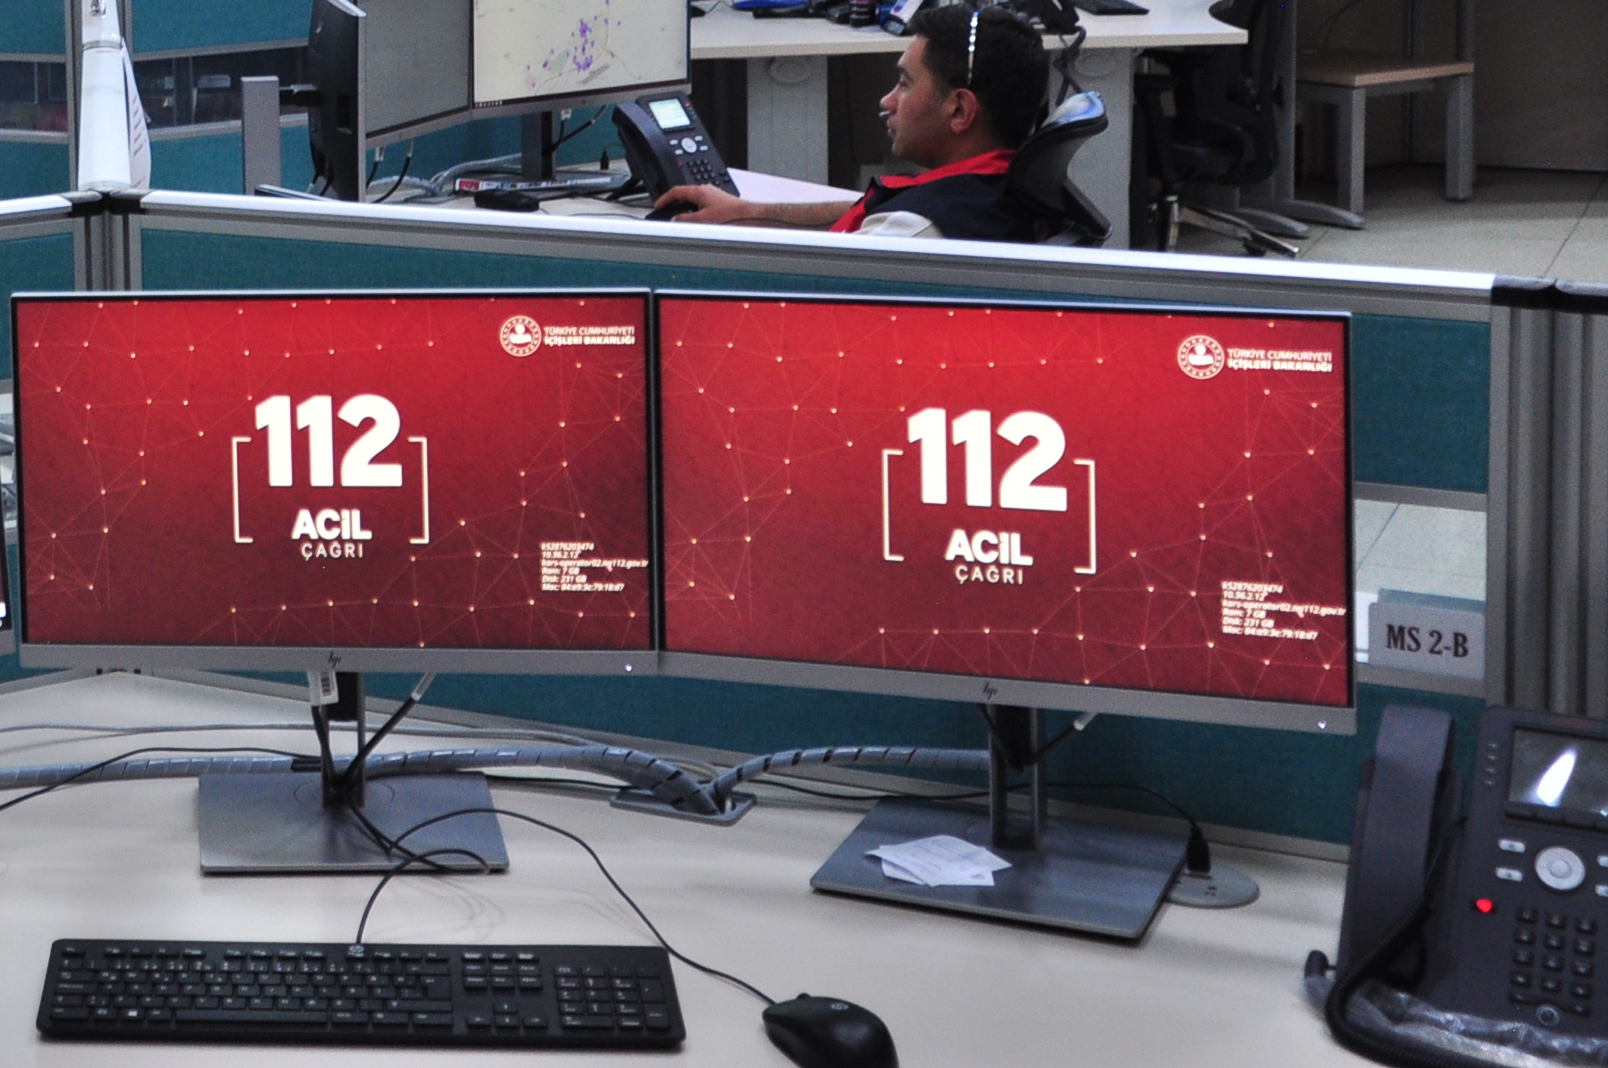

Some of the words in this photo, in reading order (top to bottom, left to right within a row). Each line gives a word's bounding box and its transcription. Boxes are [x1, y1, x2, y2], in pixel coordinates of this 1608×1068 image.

[255, 393, 403, 487] 112
[907, 407, 1068, 512] 112
[300, 541, 363, 561] ÇAĞRI
[955, 565, 1023, 584] ÇAĞRI
[1386, 624, 1421, 652] MS
[1429, 629, 1469, 658] 2-B
